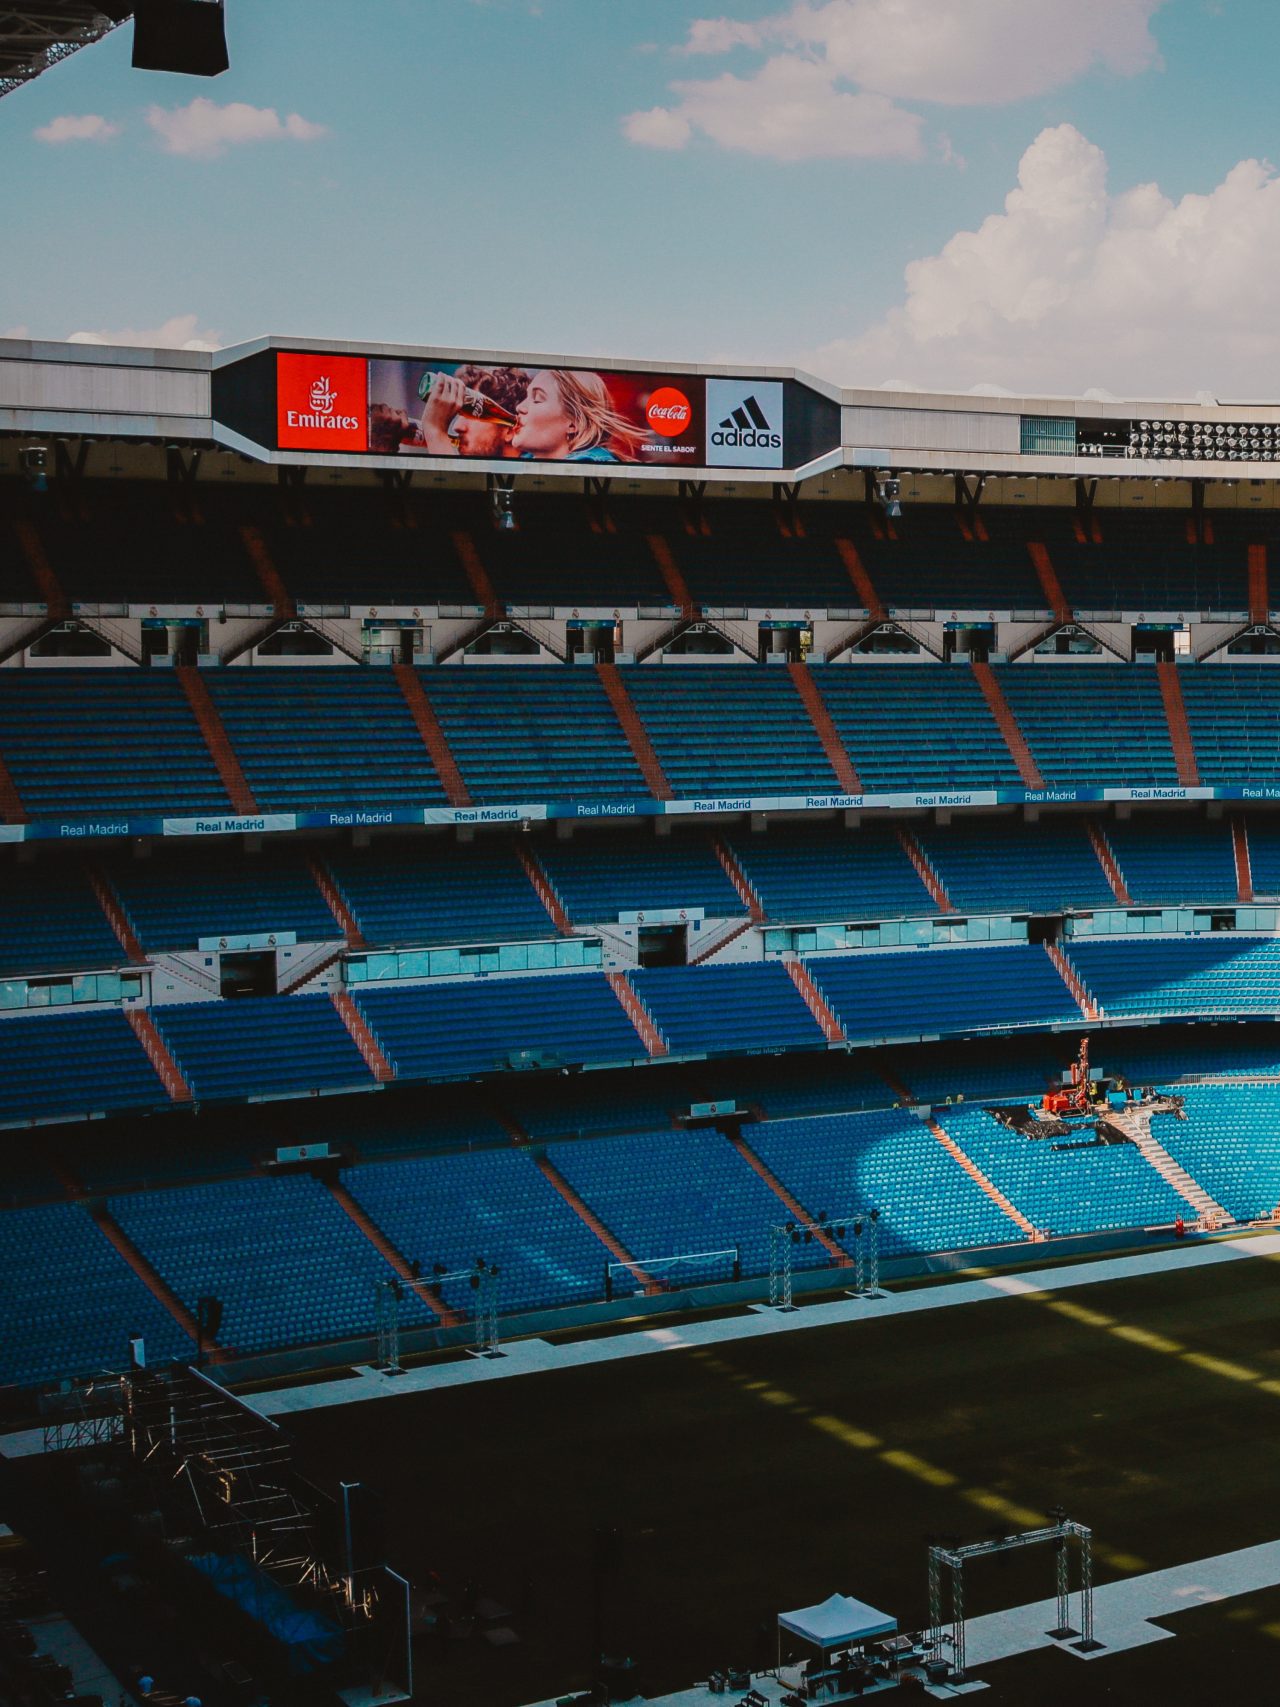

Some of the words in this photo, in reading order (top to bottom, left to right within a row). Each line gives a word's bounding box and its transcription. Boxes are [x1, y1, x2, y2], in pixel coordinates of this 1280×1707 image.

[647, 404, 688, 419] Coca-Cola
[287, 410, 359, 429] Emirates
[711, 428, 781, 448] adidas
[641, 444, 663, 452] SIENTE
[1025, 791, 1043, 800] Real
[1045, 790, 1076, 800] Madrid
[1131, 789, 1151, 798] Real
[1153, 788, 1186, 798] Madrid
[1242, 788, 1262, 797] Real
[694, 801, 715, 811] Real
[718, 799, 751, 810] Madrid
[807, 797, 828, 807] Real
[831, 796, 862, 806] Madrid
[915, 796, 936, 805] Real
[939, 794, 971, 805] Madrid
[454, 810, 480, 821] Real
[481, 809, 518, 820] Madrid
[577, 805, 599, 815] Real
[602, 804, 635, 814] Madrid
[330, 814, 352, 824] Real
[355, 812, 392, 823] Madrid
[60, 825, 85, 836] Real
[89, 823, 128, 834] Madrid
[196, 821, 222, 832] Real
[225, 820, 264, 831] Madrid
